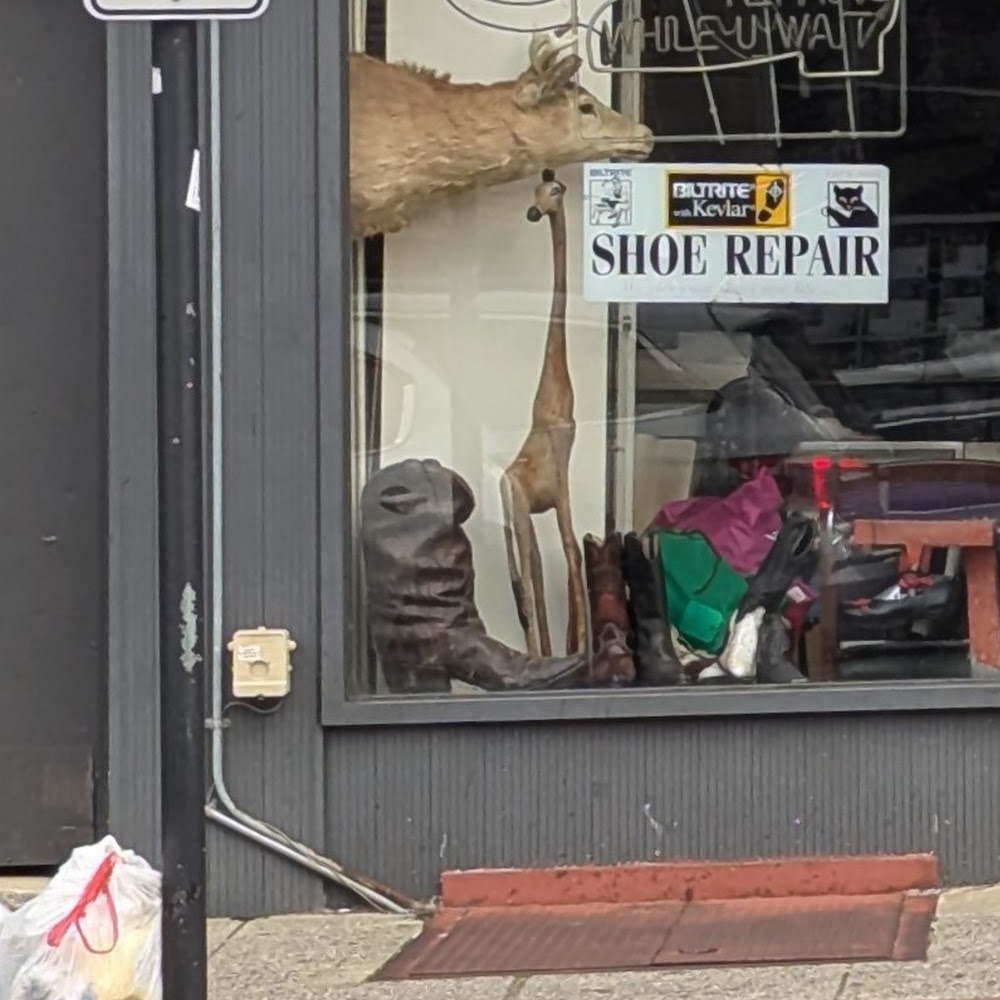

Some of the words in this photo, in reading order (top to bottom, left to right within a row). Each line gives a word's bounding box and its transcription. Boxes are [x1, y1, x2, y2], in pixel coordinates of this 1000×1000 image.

[672, 182, 750, 199] BILTRITE
[693, 200, 750, 217] Kevlar
[592, 233, 706, 276] SHOE
[725, 234, 880, 277] REPAIR
